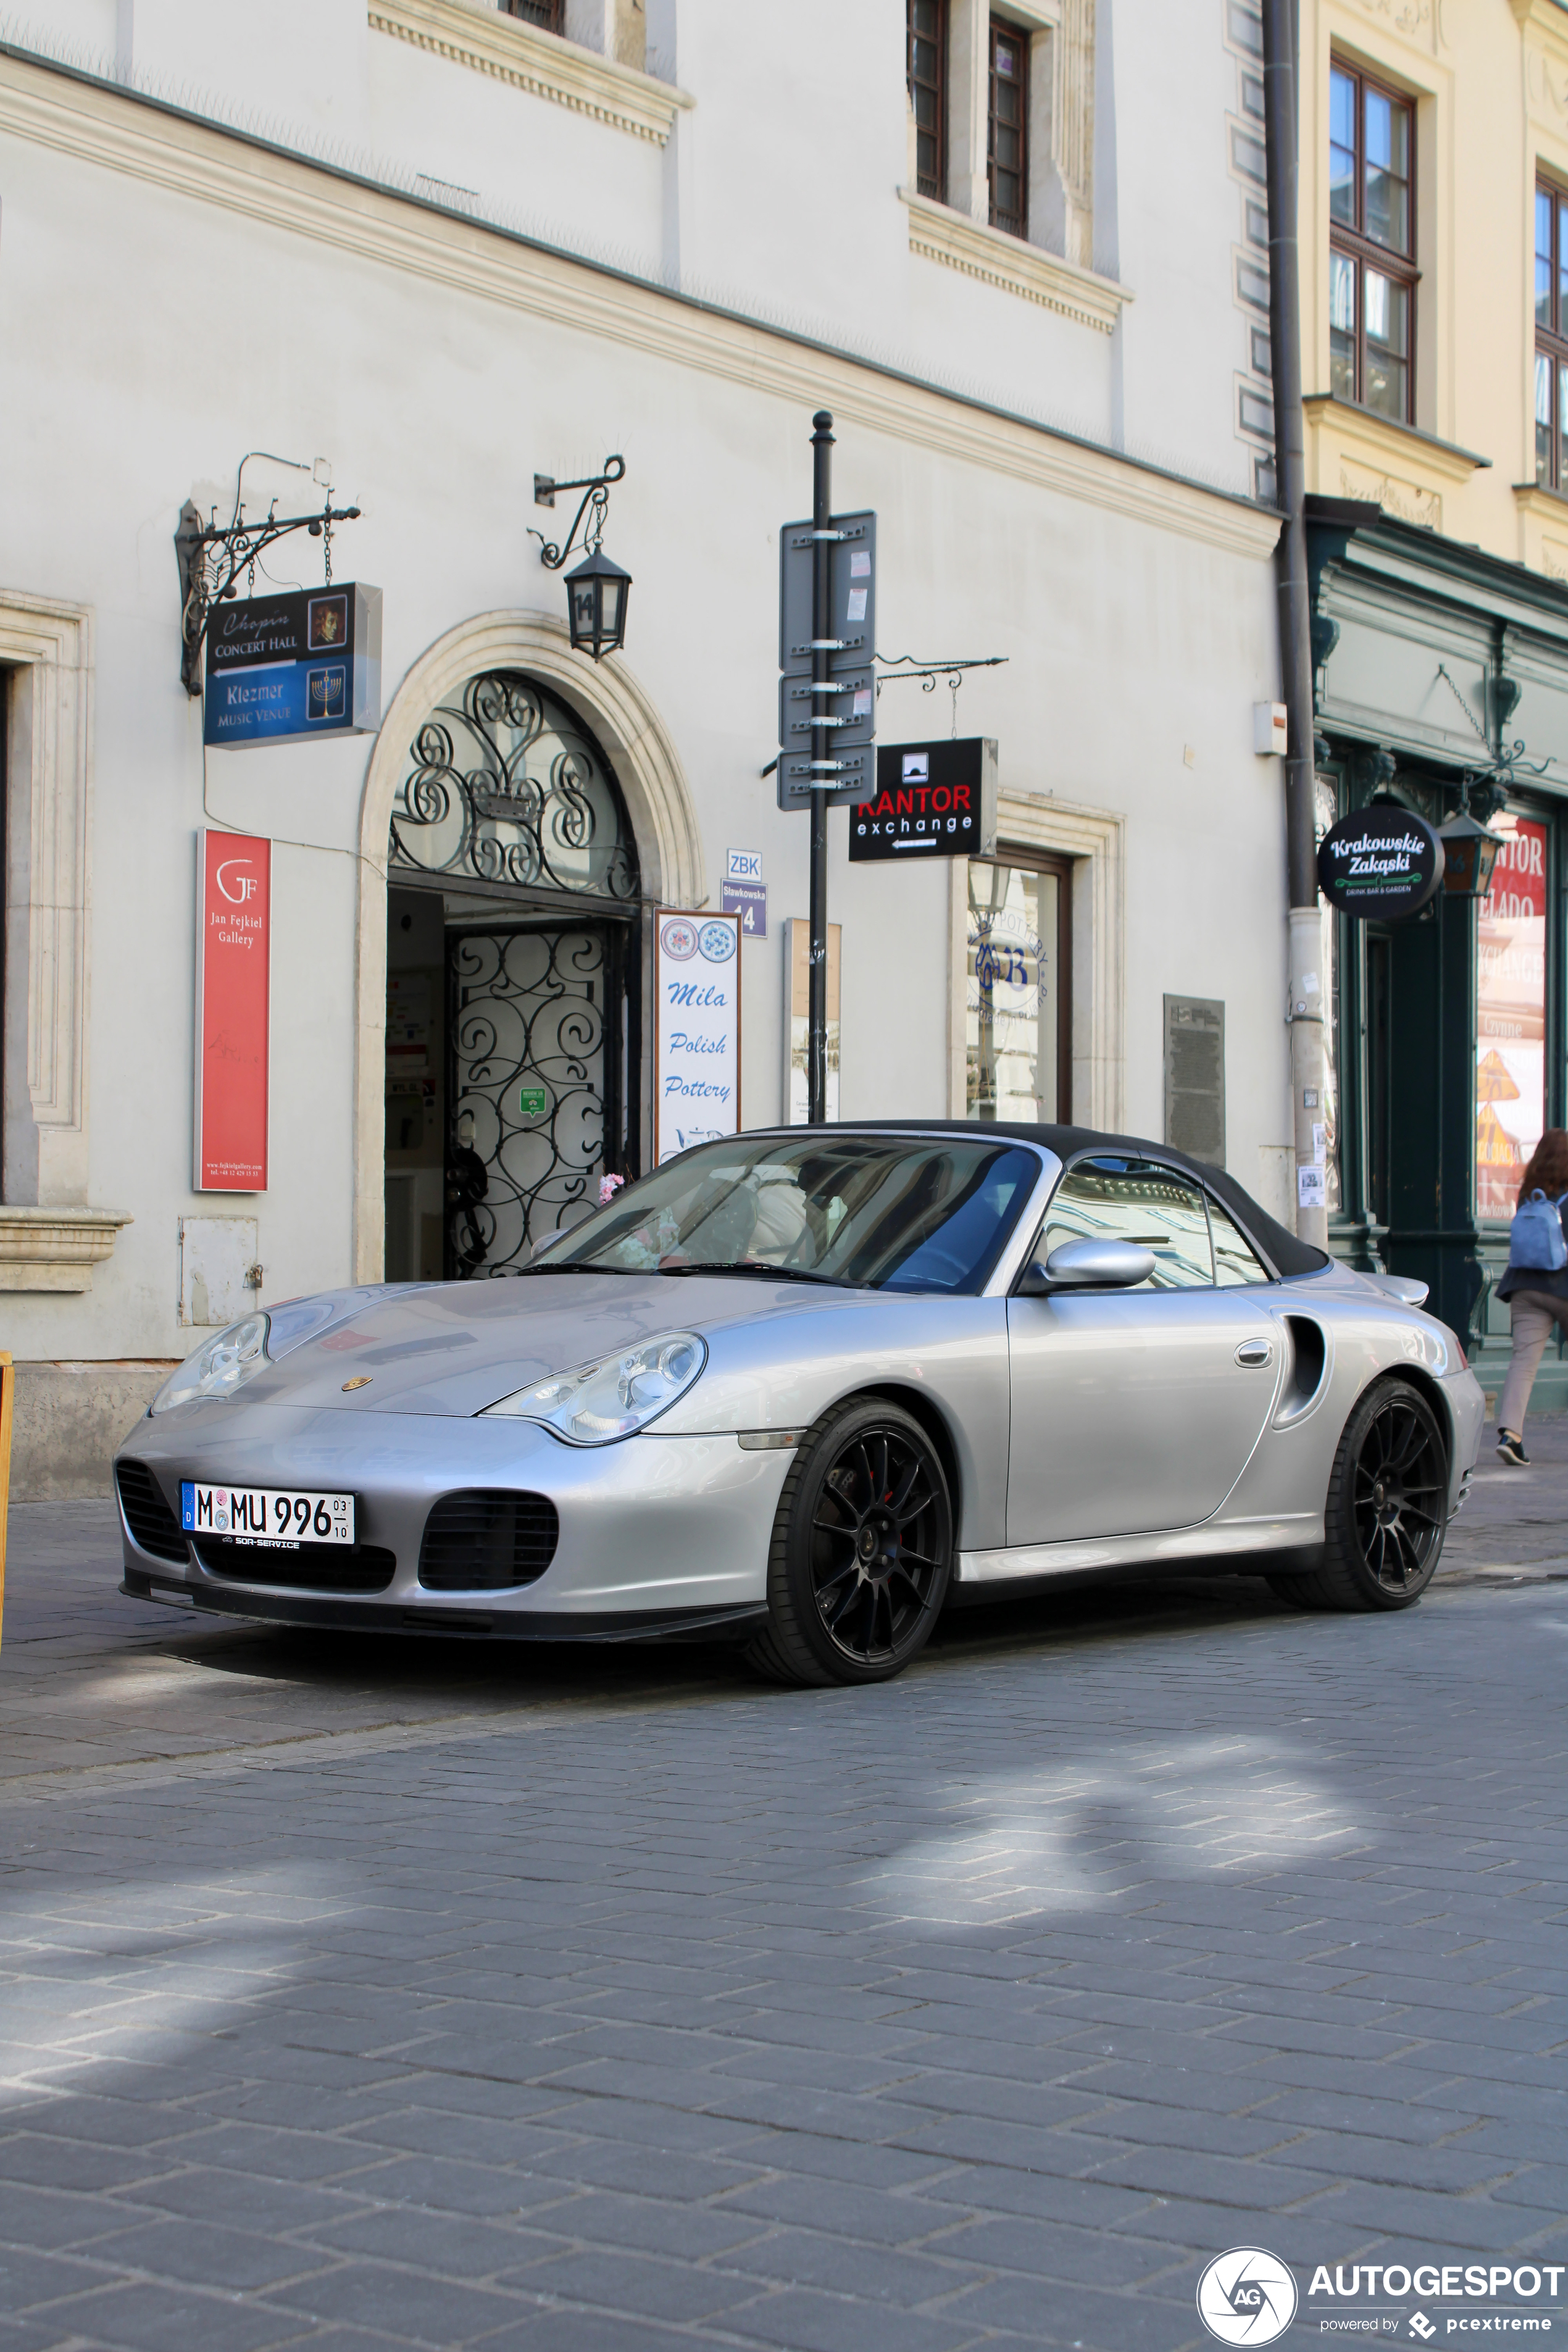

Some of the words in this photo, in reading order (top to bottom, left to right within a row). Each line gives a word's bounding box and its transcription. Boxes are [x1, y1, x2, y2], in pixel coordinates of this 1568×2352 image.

[575, 593, 593, 620] 14
[223, 610, 290, 639] Chopin
[215, 640, 266, 657] CONCERT
[269, 636, 298, 651] HALL
[227, 684, 283, 705] Klezmer
[217, 712, 253, 727] MUSIC
[255, 707, 291, 722] VENUE
[857, 816, 972, 836] exchange
[1330, 832, 1425, 859] Krakowskie
[730, 855, 759, 875] ZBK
[1348, 852, 1410, 876] Zakąski
[724, 886, 765, 900] Sławkowska
[1346, 888, 1366, 896] DRINK
[211, 912, 226, 925] Jan
[230, 914, 262, 932] Fejkiel
[219, 931, 254, 949] Gallery
[667, 982, 728, 1007] Mila
[1484, 1015, 1523, 1038] Czynne
[669, 1032, 727, 1054] Polish
[665, 1075, 731, 1103] Pottery
[207, 1162, 262, 1170] www.fejkielgallery.com
[198, 1489, 213, 1527] M
[230, 1493, 266, 1532] MU
[275, 1496, 332, 1537] 996
[333, 1500, 347, 1511] 03
[186, 1511, 191, 1522] D
[335, 1527, 347, 1538] 10
[235, 1537, 300, 1549] SOR-SERVICE
